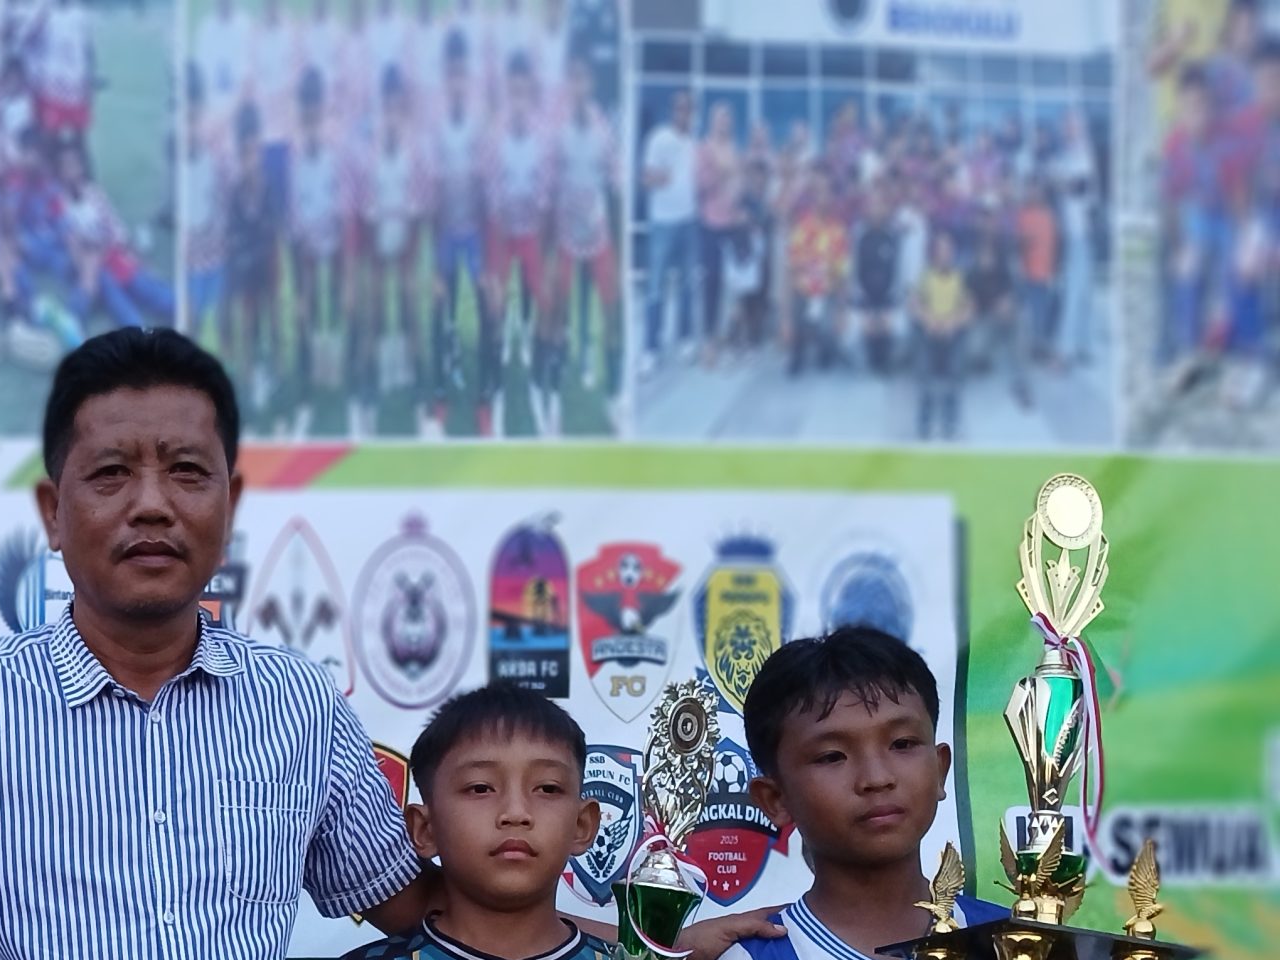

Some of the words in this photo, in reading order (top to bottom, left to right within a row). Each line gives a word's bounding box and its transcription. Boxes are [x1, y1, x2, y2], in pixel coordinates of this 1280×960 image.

[610, 676, 646, 697] FC
[708, 852, 747, 862] FOOTBALL
[717, 865, 737, 875] CLUB
